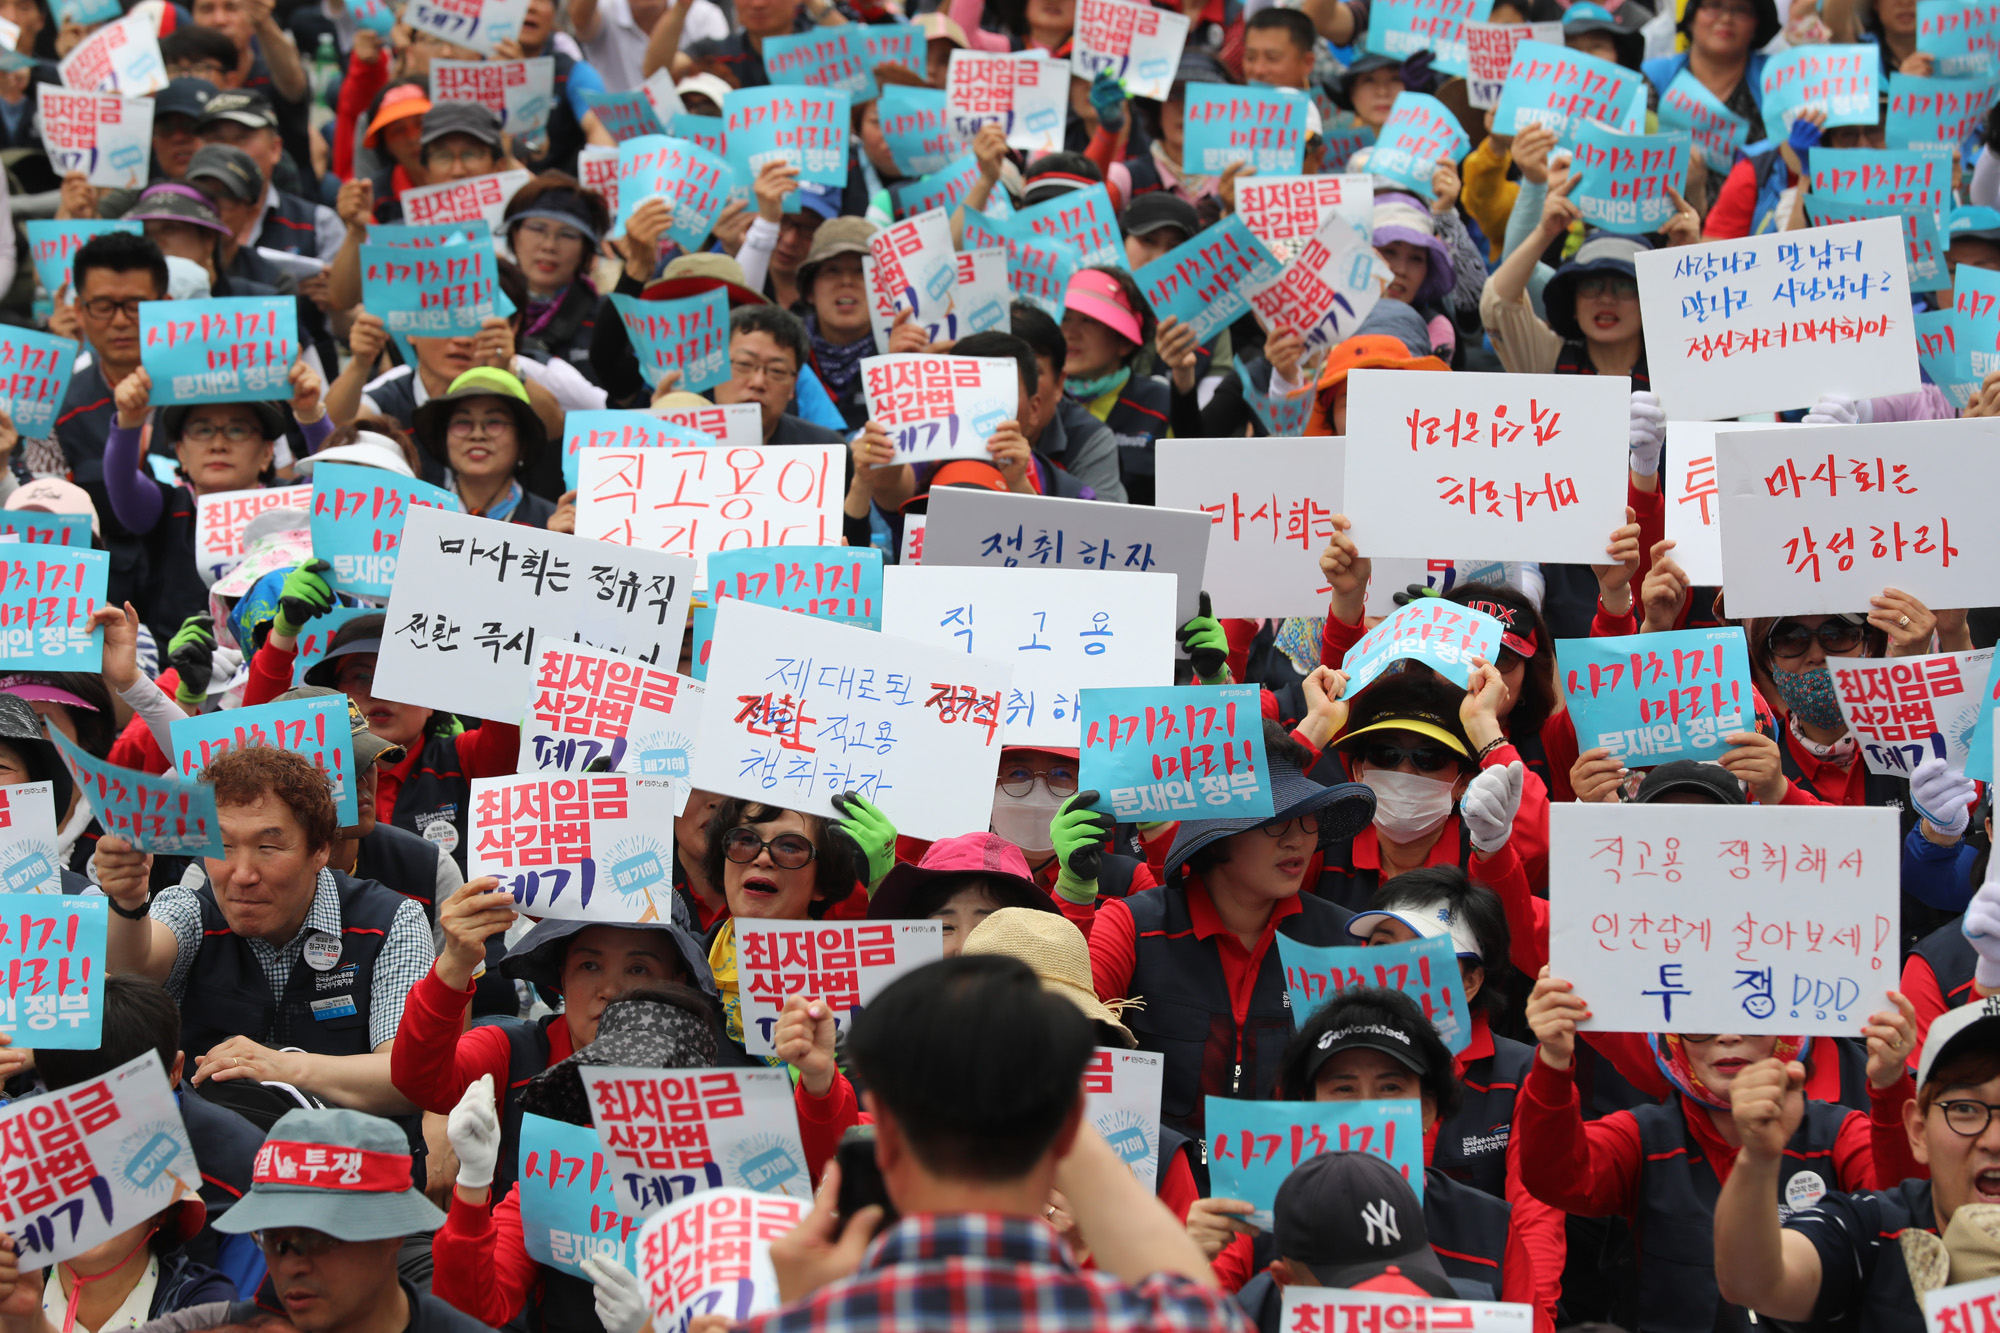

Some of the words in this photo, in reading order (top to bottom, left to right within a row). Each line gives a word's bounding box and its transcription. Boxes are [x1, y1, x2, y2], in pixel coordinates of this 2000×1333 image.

[1080, 0, 1160, 36] 최저임금
[1080, 18, 1132, 54] 삭감법
[438, 64, 526, 86] 최저임금
[954, 60, 1039, 87] 최저임금
[1512, 60, 1621, 101] 사기치지
[1766, 56, 1860, 94] 사기치지
[1804, 77, 1869, 100] 마라!
[43, 94, 121, 123] 최저임금
[730, 99, 838, 130] 사기치지
[953, 86, 1013, 112] 삭감법
[1190, 100, 1292, 126] 사기치지
[1833, 95, 1871, 115] 정부
[1893, 89, 1992, 116] 사기치지
[776, 128, 840, 149] 마라!
[1231, 128, 1297, 150] 마라!
[620, 148, 721, 186] 사기치지
[1203, 149, 1255, 170] 문재인
[1256, 149, 1296, 170] 정부
[1575, 146, 1676, 174] 사기치지
[1816, 163, 1934, 194] 사기치지
[408, 179, 502, 223] 최저임금
[1242, 178, 1341, 212] 최저임금
[1611, 172, 1680, 201] 마라!
[1245, 209, 1319, 241] 삭감법
[1580, 196, 1637, 224] 문재인
[368, 253, 480, 286] 사기치지
[1149, 233, 1240, 306] 사기치지
[1198, 247, 1264, 303] 마라!
[1252, 238, 1331, 321] 최저임금
[1673, 251, 1761, 283] 사람나고
[420, 279, 491, 310] 마라!
[1681, 286, 1753, 323] 말나고
[148, 311, 275, 349] 사기치지
[388, 308, 450, 331] 문재인
[455, 303, 495, 330] 정부
[625, 305, 713, 340] 사기치지
[207, 339, 289, 372] 마라!
[655, 329, 722, 368] 마라!
[1684, 322, 1788, 362] 정신차려
[1793, 315, 1896, 344] 마사회야
[172, 372, 241, 400] 문재인
[243, 366, 290, 392] 정부
[688, 349, 725, 384] 정부
[868, 360, 981, 397] 최저임금
[16, 400, 53, 426] 정부
[874, 389, 955, 425] 삭감법
[1406, 398, 1563, 452] 각성하라
[592, 448, 829, 520] 직고용이
[1764, 453, 1919, 498] 마사회는
[1436, 472, 1579, 522] 마사회는
[1201, 492, 1334, 550] 마사회는
[1781, 516, 1959, 583] 각성하라
[438, 535, 571, 596] 마사회는
[587, 565, 676, 625] 정규직
[715, 563, 861, 606] 사기치지
[39, 624, 93, 656] 정부
[395, 611, 460, 651] 전환
[473, 621, 536, 666] 즉시
[1345, 606, 1478, 669] 사기치지
[1404, 621, 1488, 660] 마라!
[1713, 632, 1738, 640] 민주노총
[1359, 637, 1428, 684] 문재인
[1567, 645, 1723, 699] 사기치지
[538, 651, 680, 714] 최저임금
[1227, 689, 1253, 698] 민주노총
[1838, 656, 1964, 706] 최저임금
[315, 700, 340, 710] 민주노총
[534, 692, 635, 739] 삭감법
[1640, 680, 1740, 725] 마라!
[1849, 700, 1938, 742] 삭감법
[817, 713, 898, 756] 직고용
[1087, 702, 1236, 753] 사기치지
[1598, 721, 1684, 762] 문재인
[1686, 712, 1746, 749] 정부
[1151, 738, 1254, 782] 마라!
[1865, 732, 1947, 772] 폐기
[24, 788, 48, 796] 민주노총
[644, 779, 670, 788] 민주노총
[1109, 779, 1198, 818] 문재인
[1199, 771, 1260, 807] 정부
[104, 806, 206, 838] 마라!
[475, 777, 628, 829] 최저임금
[476, 823, 591, 867] 삭감법
[9, 860, 50, 892] 폐기해
[616, 856, 661, 886] 폐기해
[72, 901, 99, 910] 민주노총
[308, 942, 326, 952] 정규직
[327, 943, 340, 953] 전환
[743, 925, 895, 972] 최저임금
[910, 925, 937, 934] 민주노총
[1591, 910, 1712, 954] 인간답게
[1731, 910, 1891, 971] 살아보세!
[748, 970, 860, 1012] 삭감법
[24, 993, 90, 1031] 정부
[1131, 1056, 1158, 1066] 민주노총
[592, 1073, 744, 1124] 최저임금
[607, 1123, 713, 1170] 삭감법
[1215, 1121, 1395, 1169] 사기치지
[254, 1146, 271, 1178] 결
[299, 1148, 363, 1185] 투쟁
[746, 1152, 794, 1188] 폐기해
[643, 1197, 803, 1281] 최저임금
[1360, 1199, 1402, 1247] NY
[549, 1228, 628, 1267] 문재인
[648, 1239, 754, 1317] 삭감법
